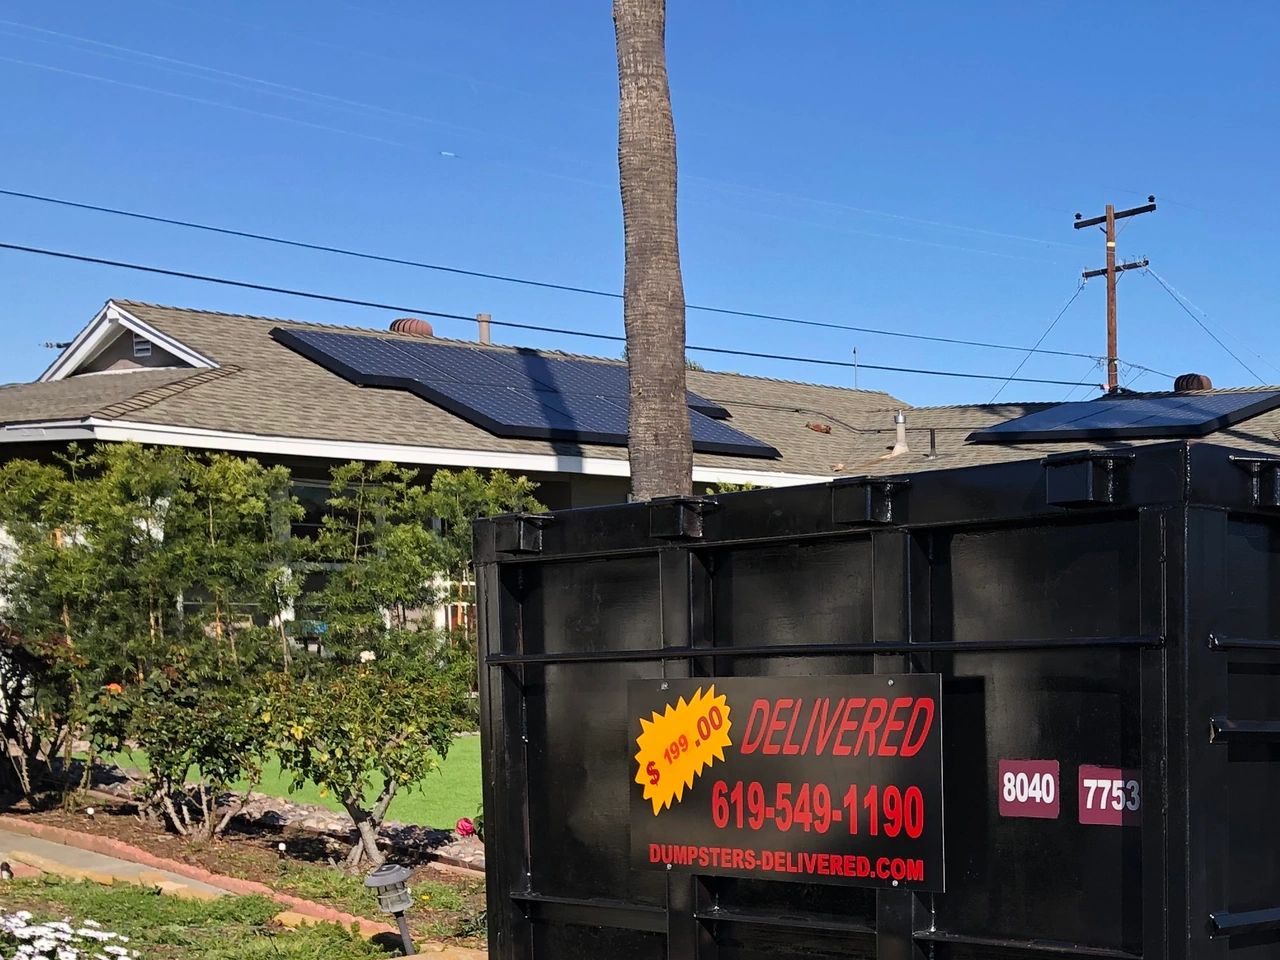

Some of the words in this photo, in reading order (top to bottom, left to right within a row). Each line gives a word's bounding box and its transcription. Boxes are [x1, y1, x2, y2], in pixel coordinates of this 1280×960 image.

[740, 696, 934, 757] DELIVERED
[1003, 771, 1055, 804] 8040
[1083, 779, 1140, 811] 7753
[712, 780, 924, 838] 619-549-1190
[648, 843, 923, 881] DUMPSTERS-DELIVERED.COM
